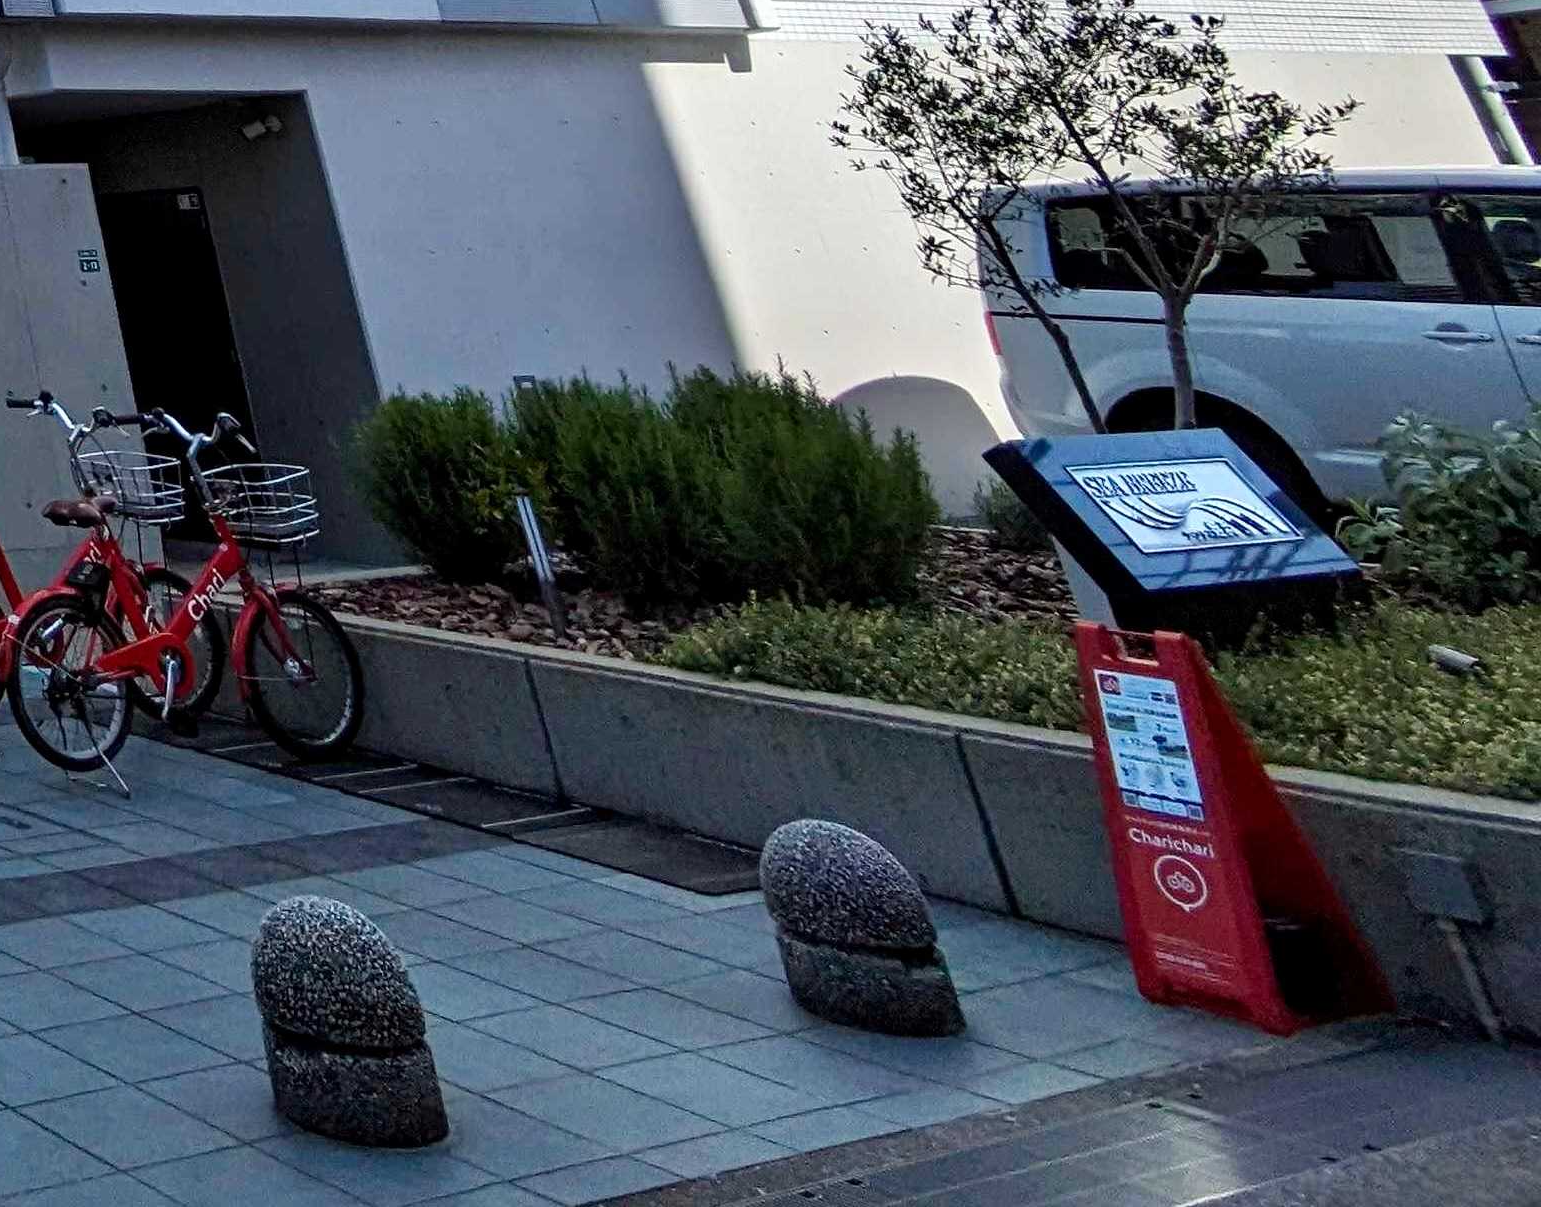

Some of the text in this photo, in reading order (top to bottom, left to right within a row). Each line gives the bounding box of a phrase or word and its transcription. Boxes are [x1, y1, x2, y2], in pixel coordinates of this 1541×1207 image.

[1083, 475, 1124, 498] SEA
[188, 567, 227, 622] Chari
[1128, 827, 1215, 859] Charichari
